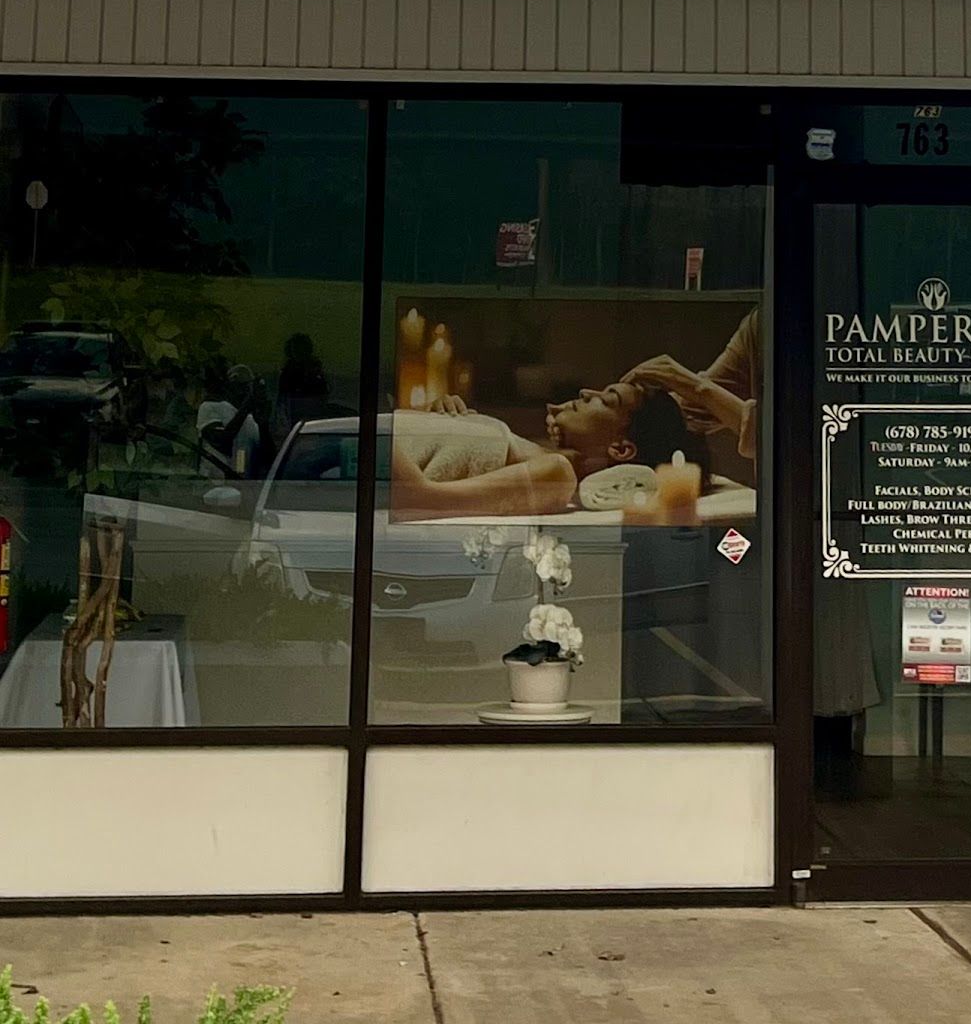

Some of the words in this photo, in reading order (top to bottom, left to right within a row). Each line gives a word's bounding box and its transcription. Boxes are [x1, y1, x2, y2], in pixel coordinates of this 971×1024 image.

[916, 106, 940, 117] 763
[896, 123, 950, 156] 763
[825, 347, 887, 363] TOTAL
[826, 373, 841, 383] WE
[845, 373, 874, 383] MAKE
[888, 373, 911, 383] OUR
[913, 373, 959, 384] BUSINESS
[885, 426, 919, 439] (678)
[878, 457, 934, 467] SATURDAY
[875, 486, 921, 496] FACIALS,
[924, 486, 953, 495] BODY
[848, 500, 875, 510] FULL
[861, 515, 904, 525] LASHES,
[907, 515, 939, 525] BROW
[893, 529, 952, 539] CHEMICAL
[860, 543, 896, 553] TEETH
[899, 543, 966, 553] WHITENING
[905, 587, 969, 597] ATTENTION!
